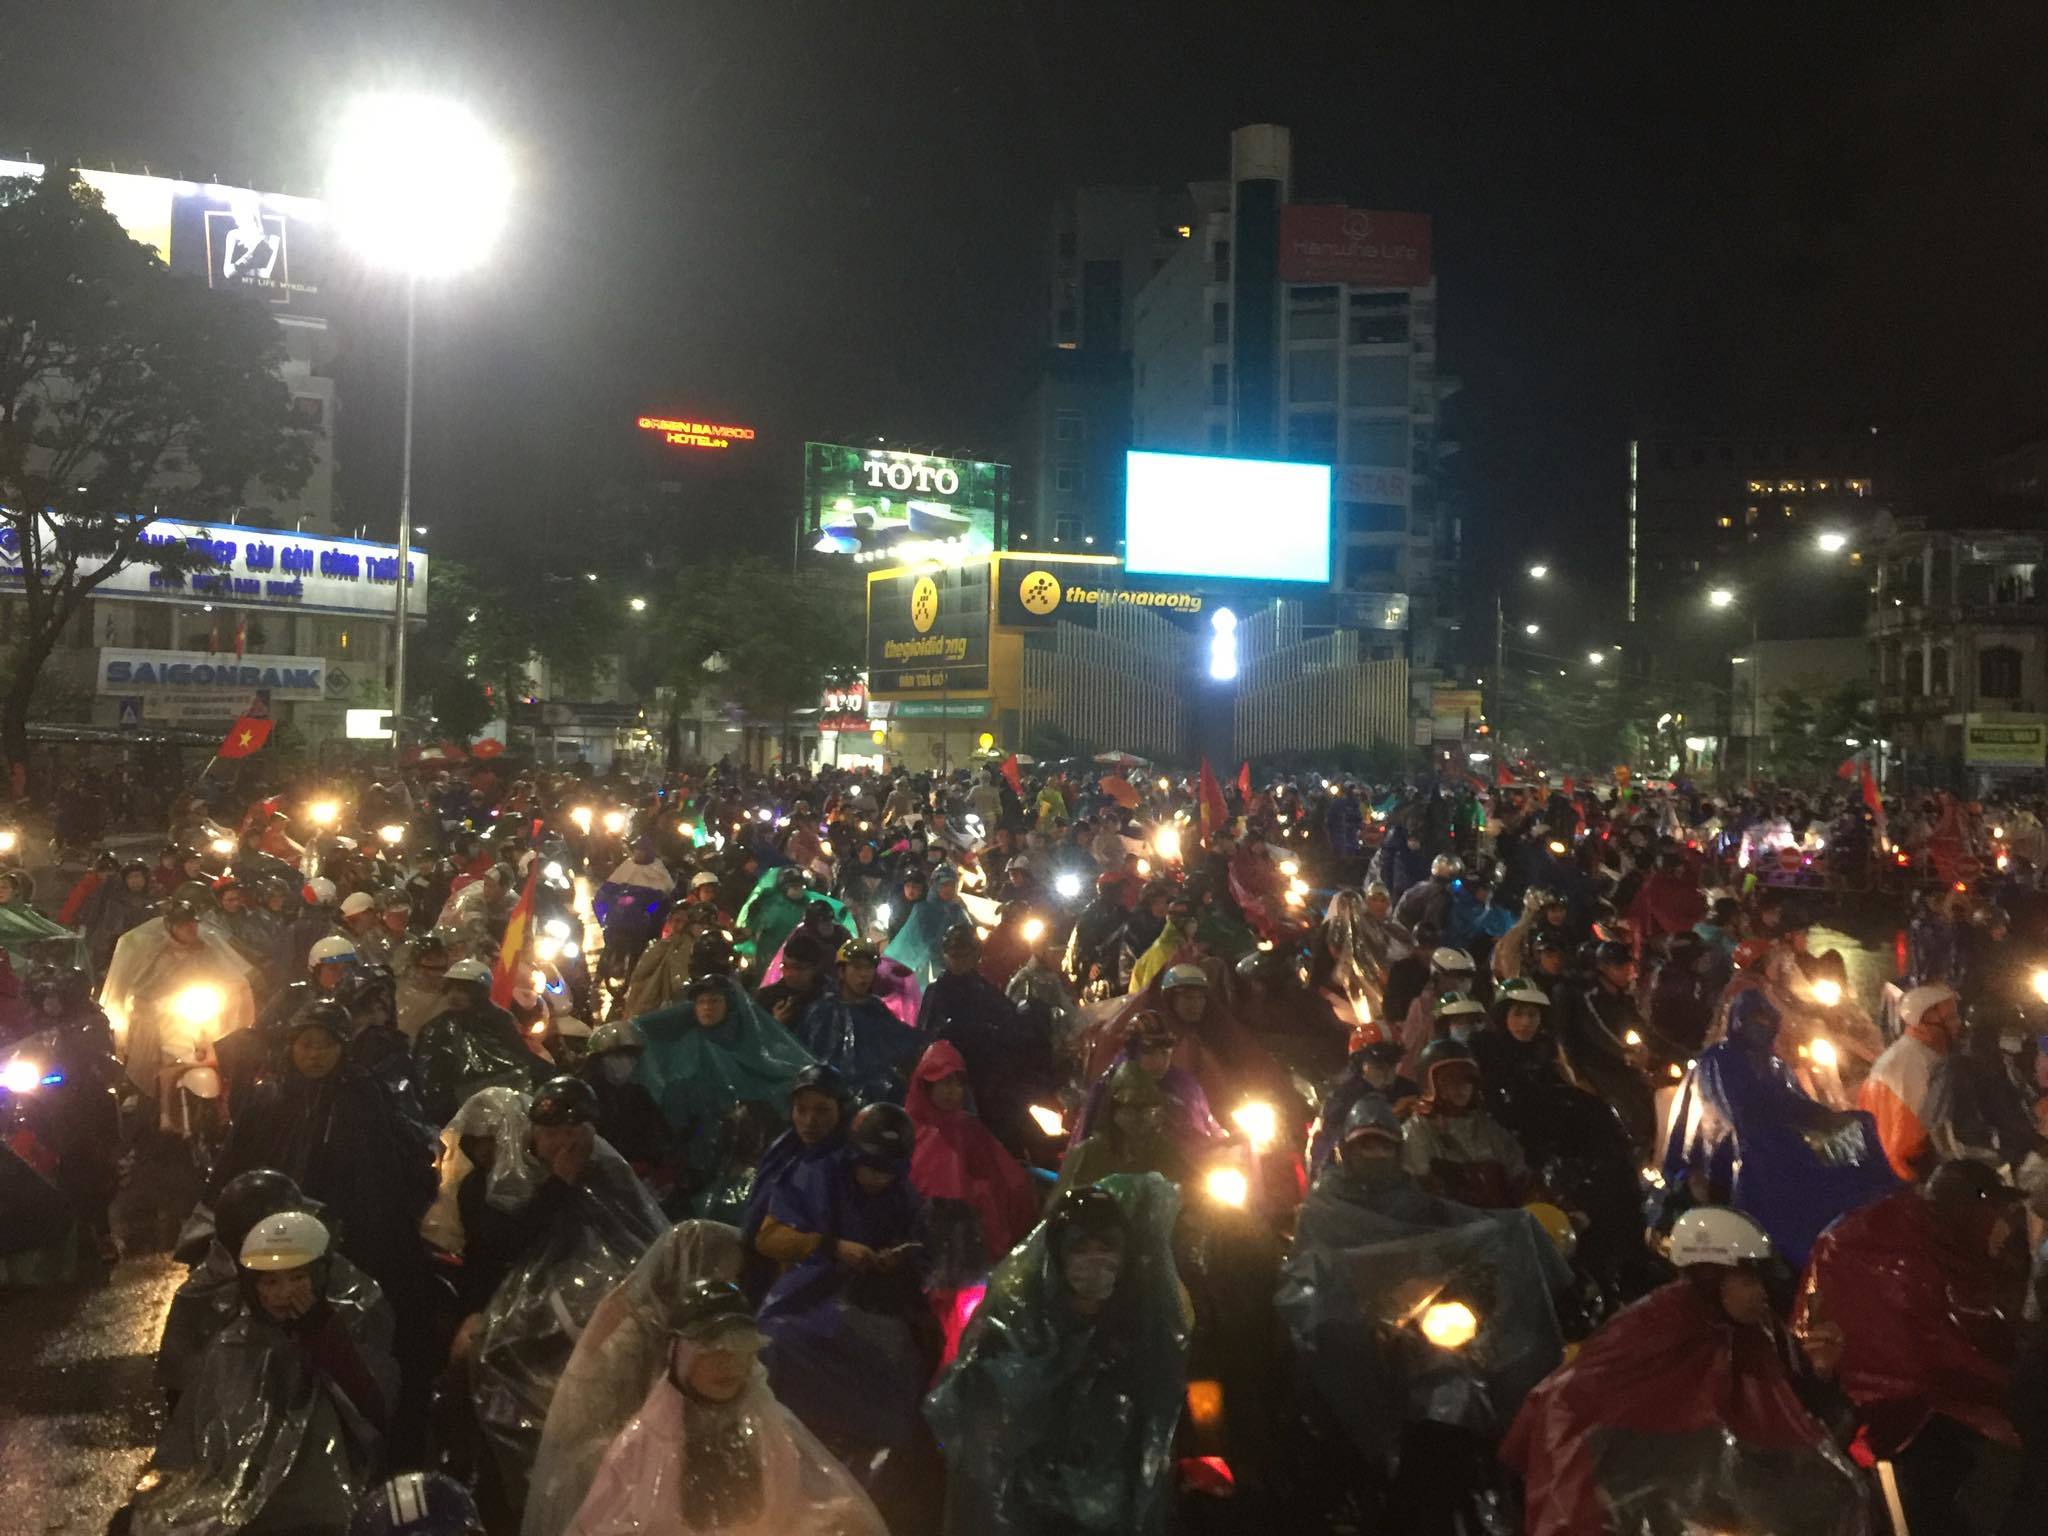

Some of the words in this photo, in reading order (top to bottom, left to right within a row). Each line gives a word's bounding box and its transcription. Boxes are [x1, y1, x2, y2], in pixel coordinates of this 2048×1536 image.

[258, 279, 275, 288] LIFE
[639, 418, 691, 432] GREEN
[692, 424, 754, 439] BAMBOO
[667, 433, 715, 447] HOTEL
[863, 460, 958, 494] TOTO
[107, 661, 321, 690] SAIGONBANK
